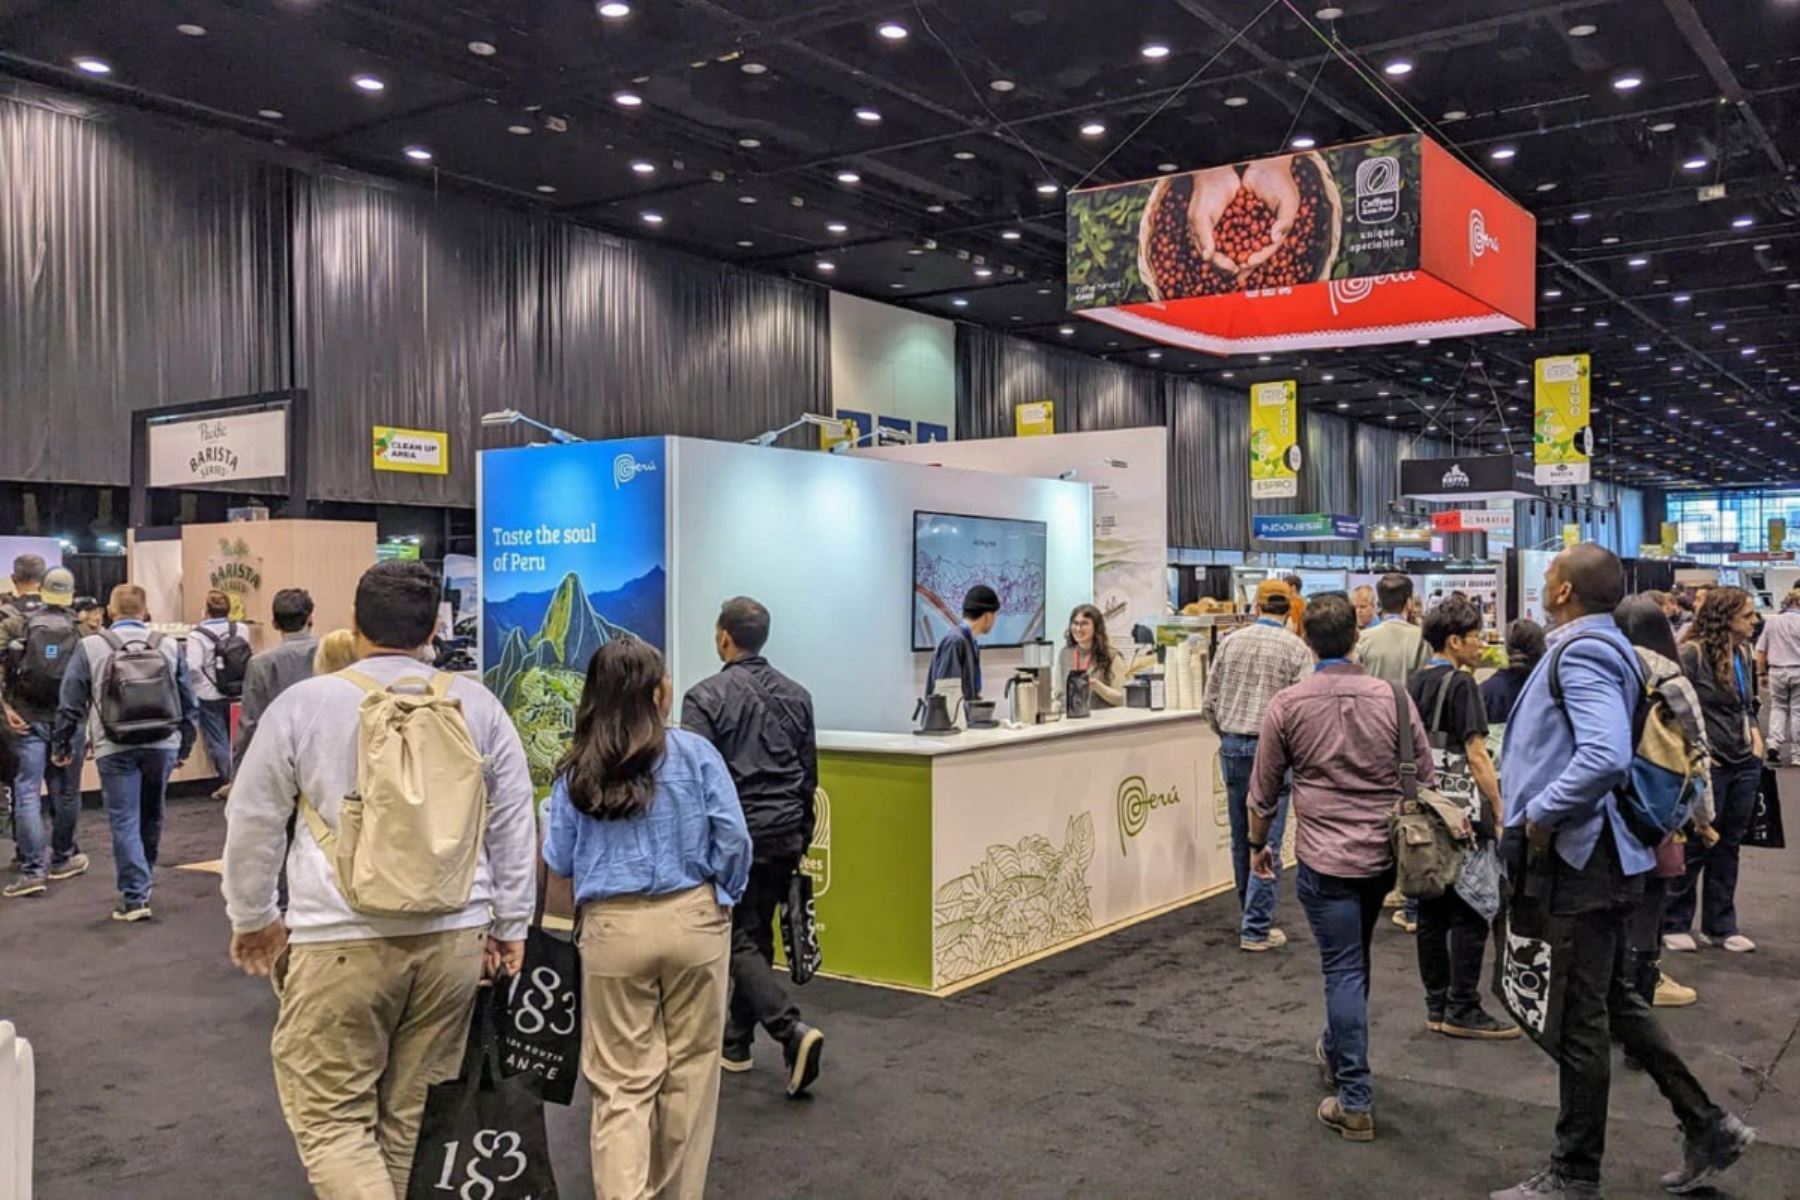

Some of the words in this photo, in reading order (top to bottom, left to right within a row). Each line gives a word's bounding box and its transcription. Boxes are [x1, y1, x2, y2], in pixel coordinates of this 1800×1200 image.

[391, 442, 422, 450] CLEAN
[189, 446, 239, 473] BARISTA
[613, 454, 657, 490] Perú
[1257, 480, 1291, 492] ESPRO
[493, 526, 533, 547] Taste
[536, 524, 561, 545] the
[563, 522, 597, 544] soul
[493, 552, 509, 572] of
[510, 552, 546, 572] Peru
[210, 562, 261, 590] BARISTA
[1117, 775, 1180, 859] Perú
